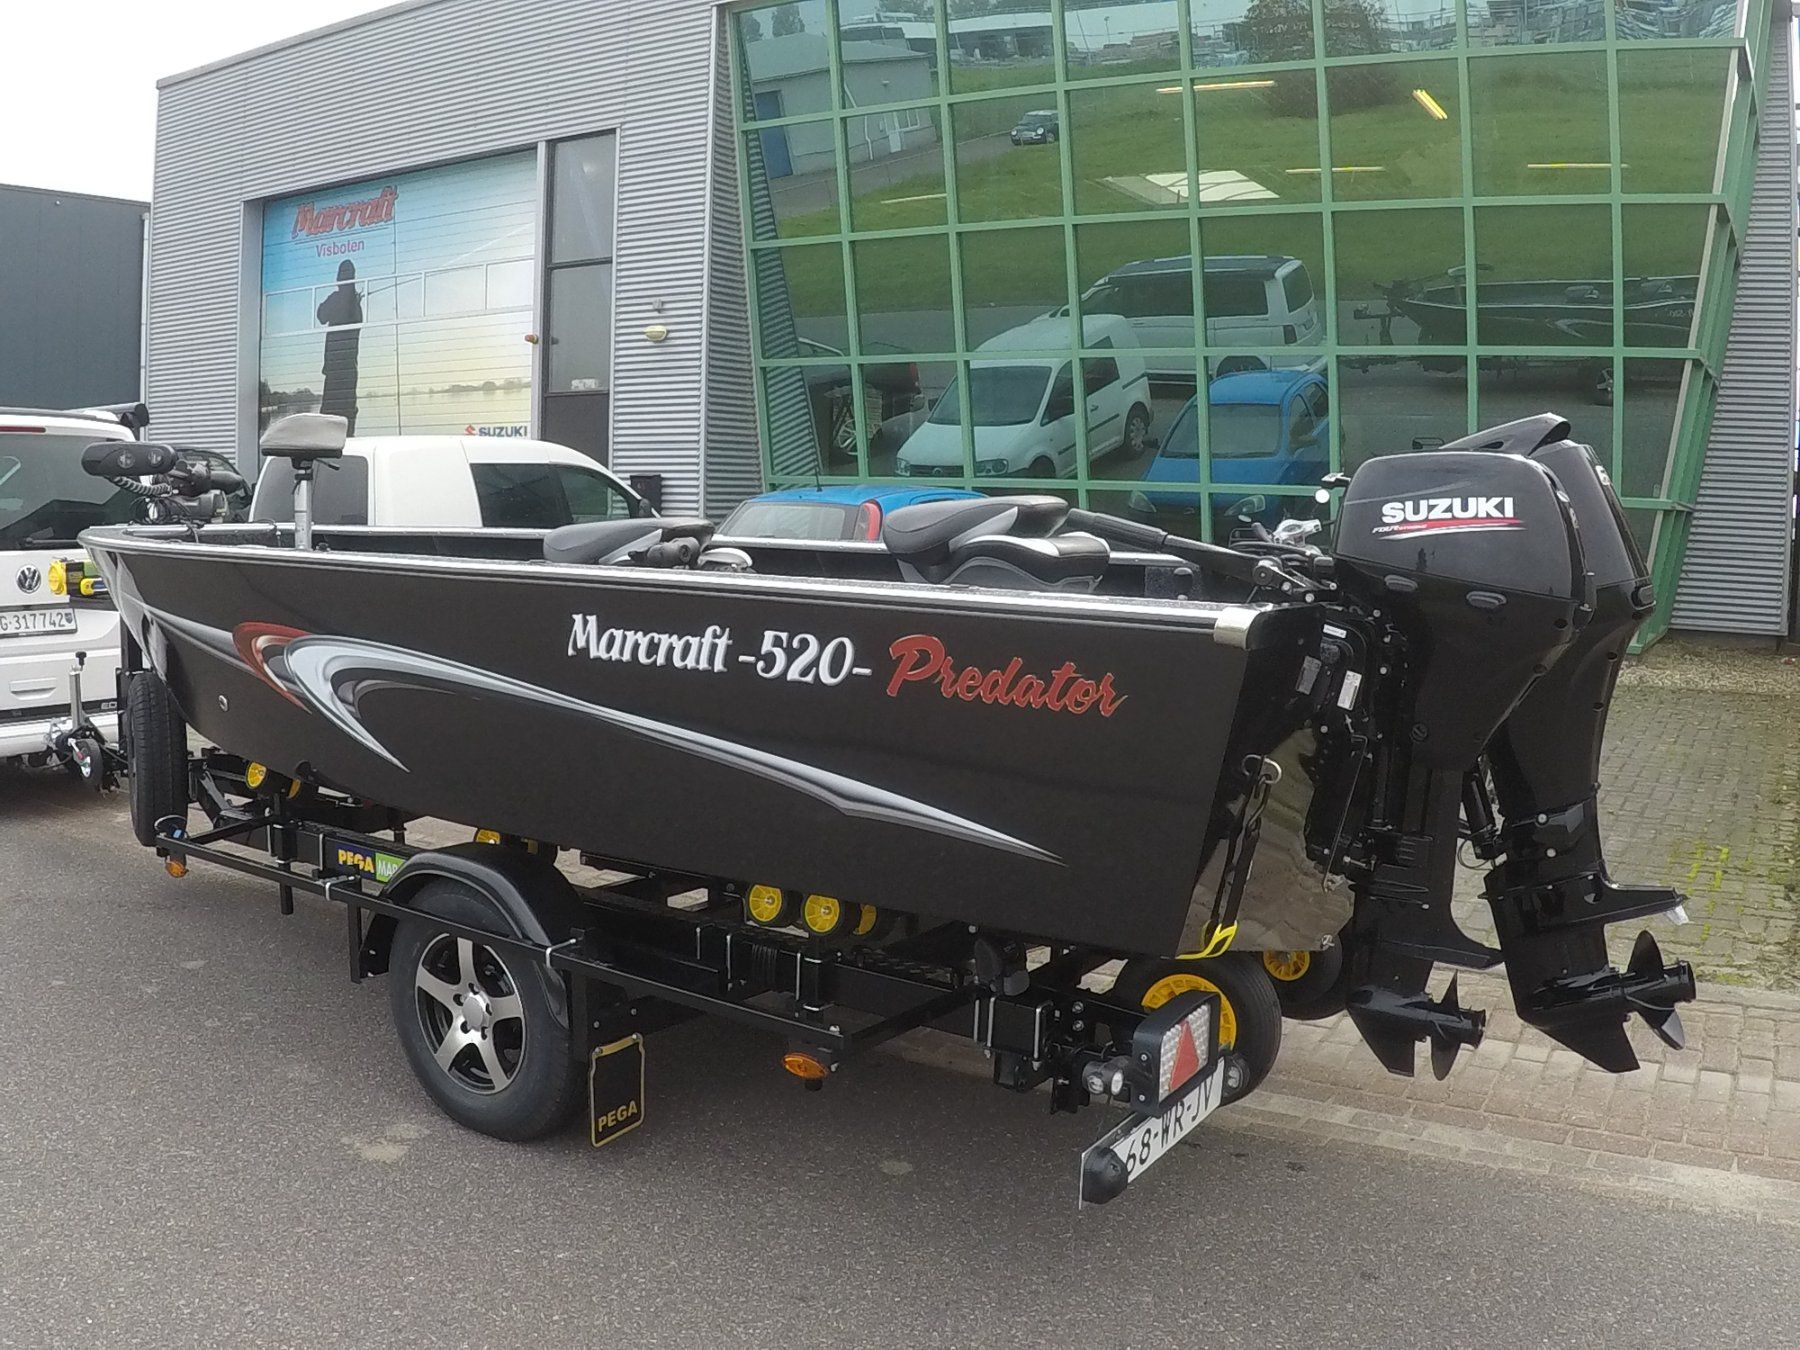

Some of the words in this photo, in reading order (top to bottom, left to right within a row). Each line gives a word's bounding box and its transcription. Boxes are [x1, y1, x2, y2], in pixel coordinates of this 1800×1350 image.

[291, 185, 399, 239] Marcraft
[316, 240, 364, 257] Visboten
[478, 425, 528, 437] SUZUKI
[1381, 497, 1514, 524] SUZUKI
[567, 613, 733, 673] Marcraft
[738, 630, 872, 686] -520-
[886, 634, 1128, 717] Predator
[338, 849, 375, 873] PEGA
[598, 1100, 638, 1132] PEGA
